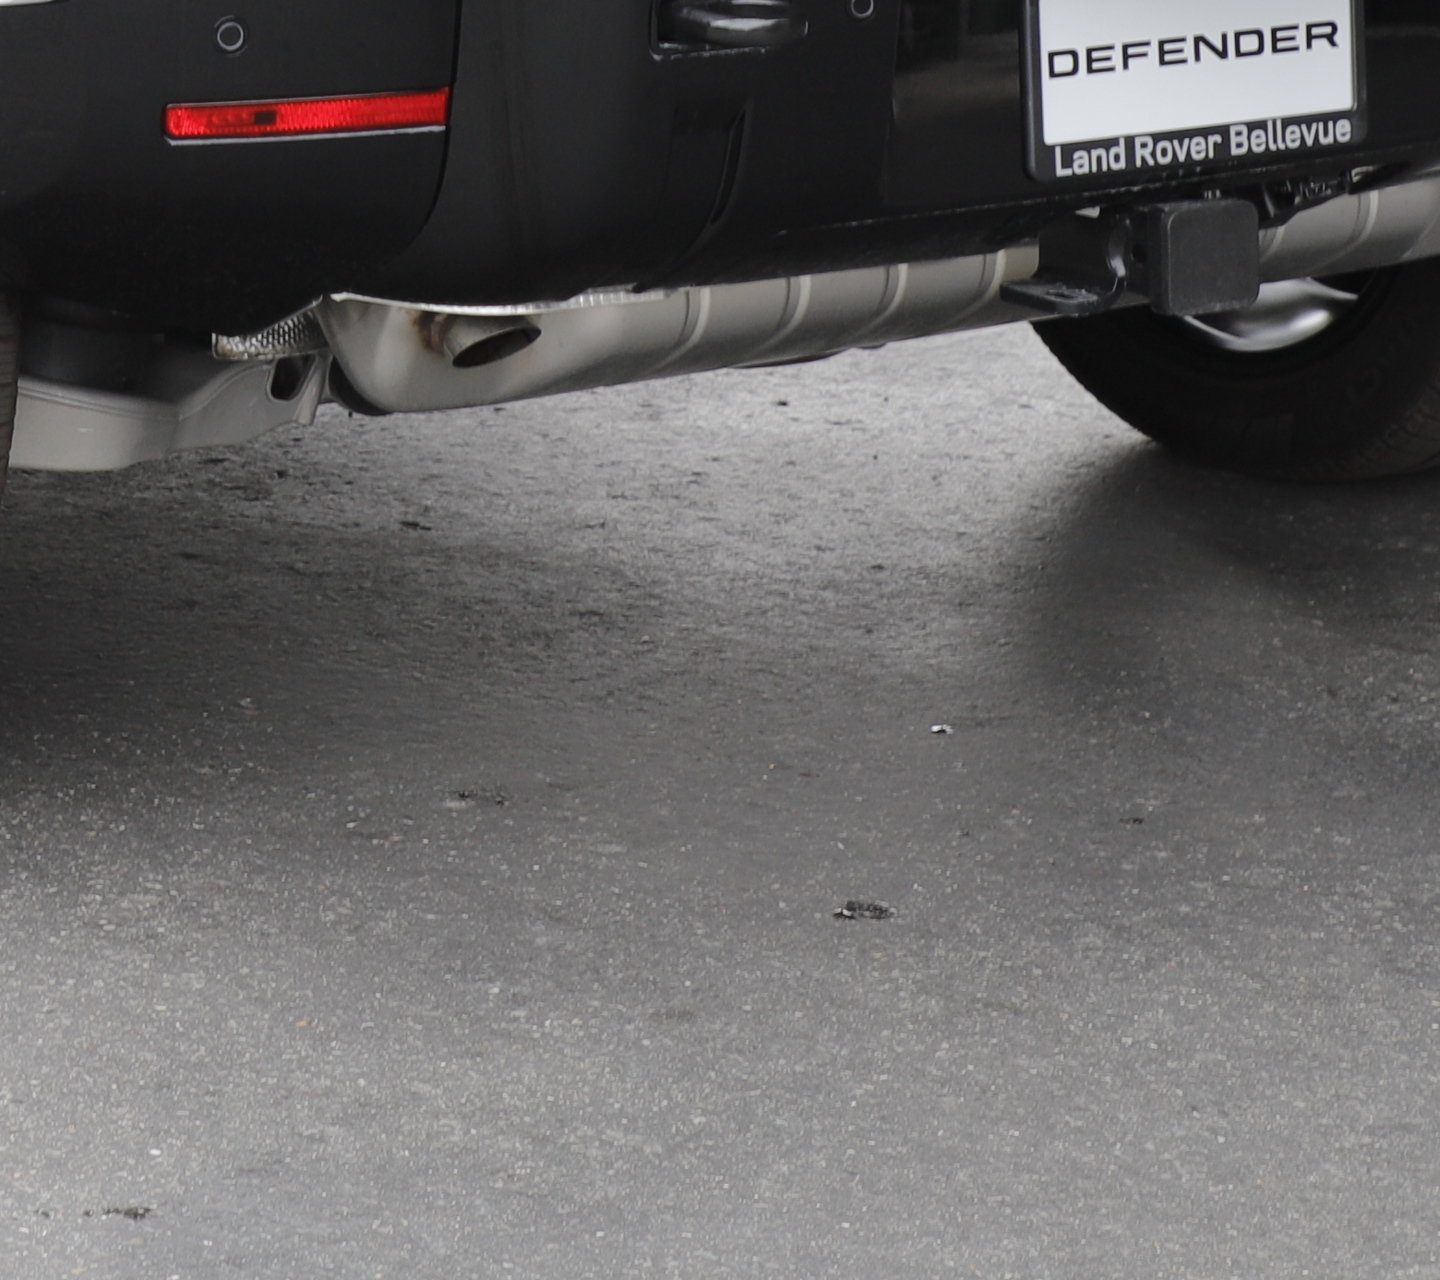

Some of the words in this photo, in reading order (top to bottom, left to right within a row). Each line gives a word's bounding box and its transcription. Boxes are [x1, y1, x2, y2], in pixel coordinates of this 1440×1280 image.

[1047, 21, 1339, 79] DEFENDER
[1054, 136, 1126, 178] Land
[1134, 133, 1222, 170] Rover
[1230, 117, 1353, 157] Bellevue
